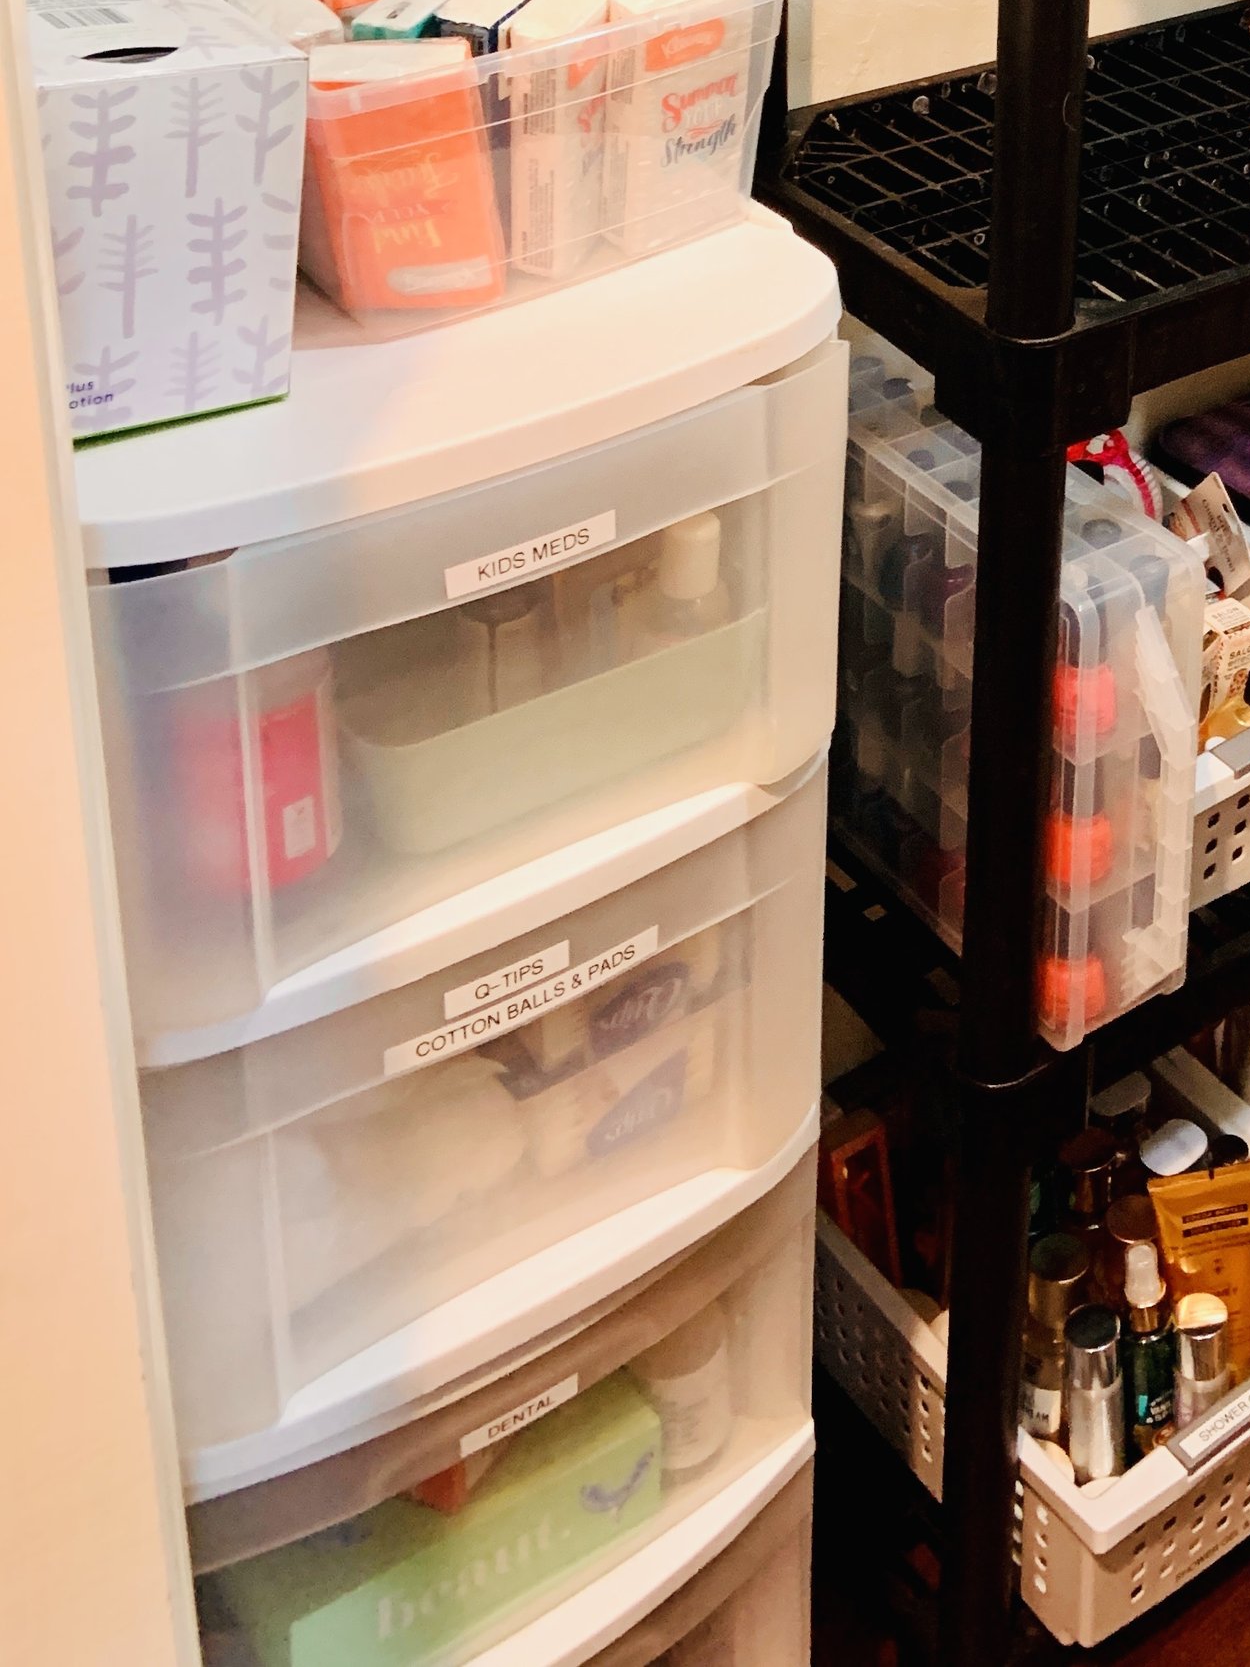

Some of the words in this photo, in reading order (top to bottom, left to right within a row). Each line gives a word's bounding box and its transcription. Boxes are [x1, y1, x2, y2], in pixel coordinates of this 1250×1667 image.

[660, 114, 737, 168] Strength
[66, 381, 94, 394] lus
[478, 551, 525, 581] KIDS
[532, 528, 590, 563] MEDS
[415, 1011, 501, 1058] COTTON
[507, 981, 565, 1021] BALLS
[571, 973, 583, 990] &
[588, 944, 636, 982] PADS
[474, 958, 544, 1001] Q-TIPS
[487, 1395, 555, 1439] DENTAL
[1199, 1401, 1248, 1442] SHOWER
